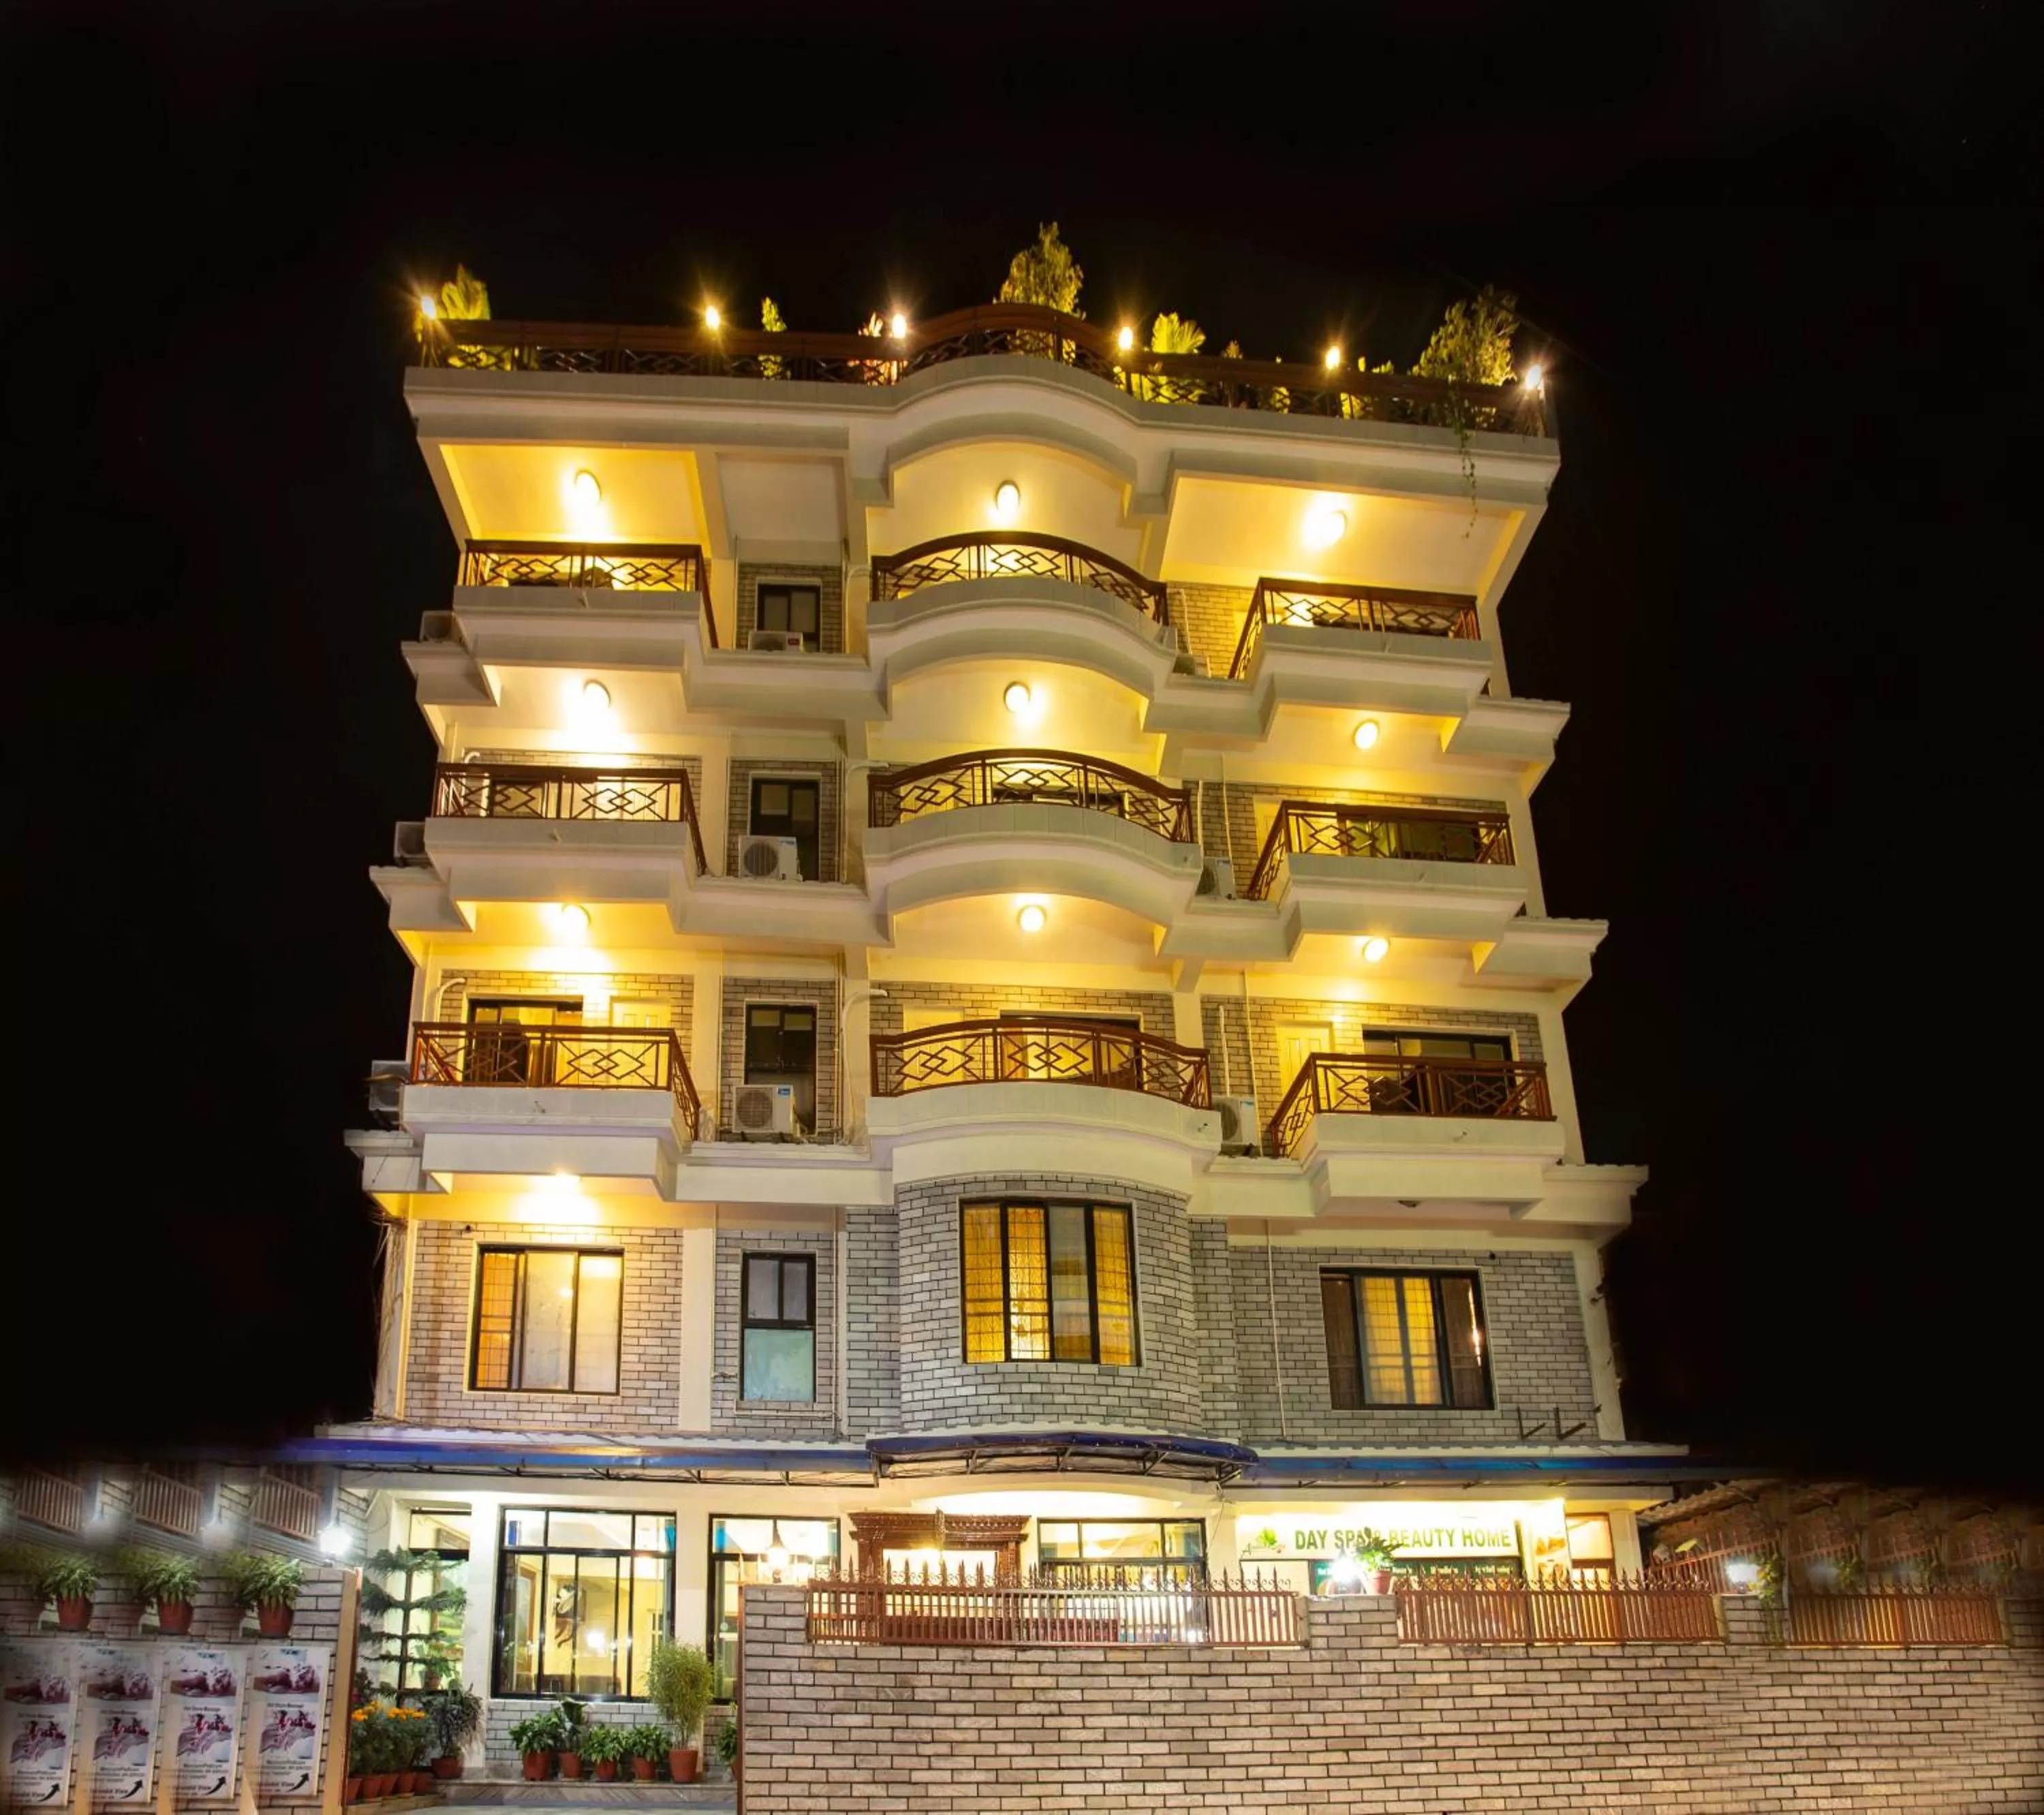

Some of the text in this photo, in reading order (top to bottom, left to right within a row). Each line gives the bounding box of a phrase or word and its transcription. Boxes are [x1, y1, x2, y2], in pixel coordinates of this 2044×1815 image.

[1295, 1530, 1328, 1550] DAY
[1334, 1529, 1367, 1549] SPA
[1389, 1527, 1455, 1548] BEAUTY
[1461, 1527, 1511, 1548] HOME
